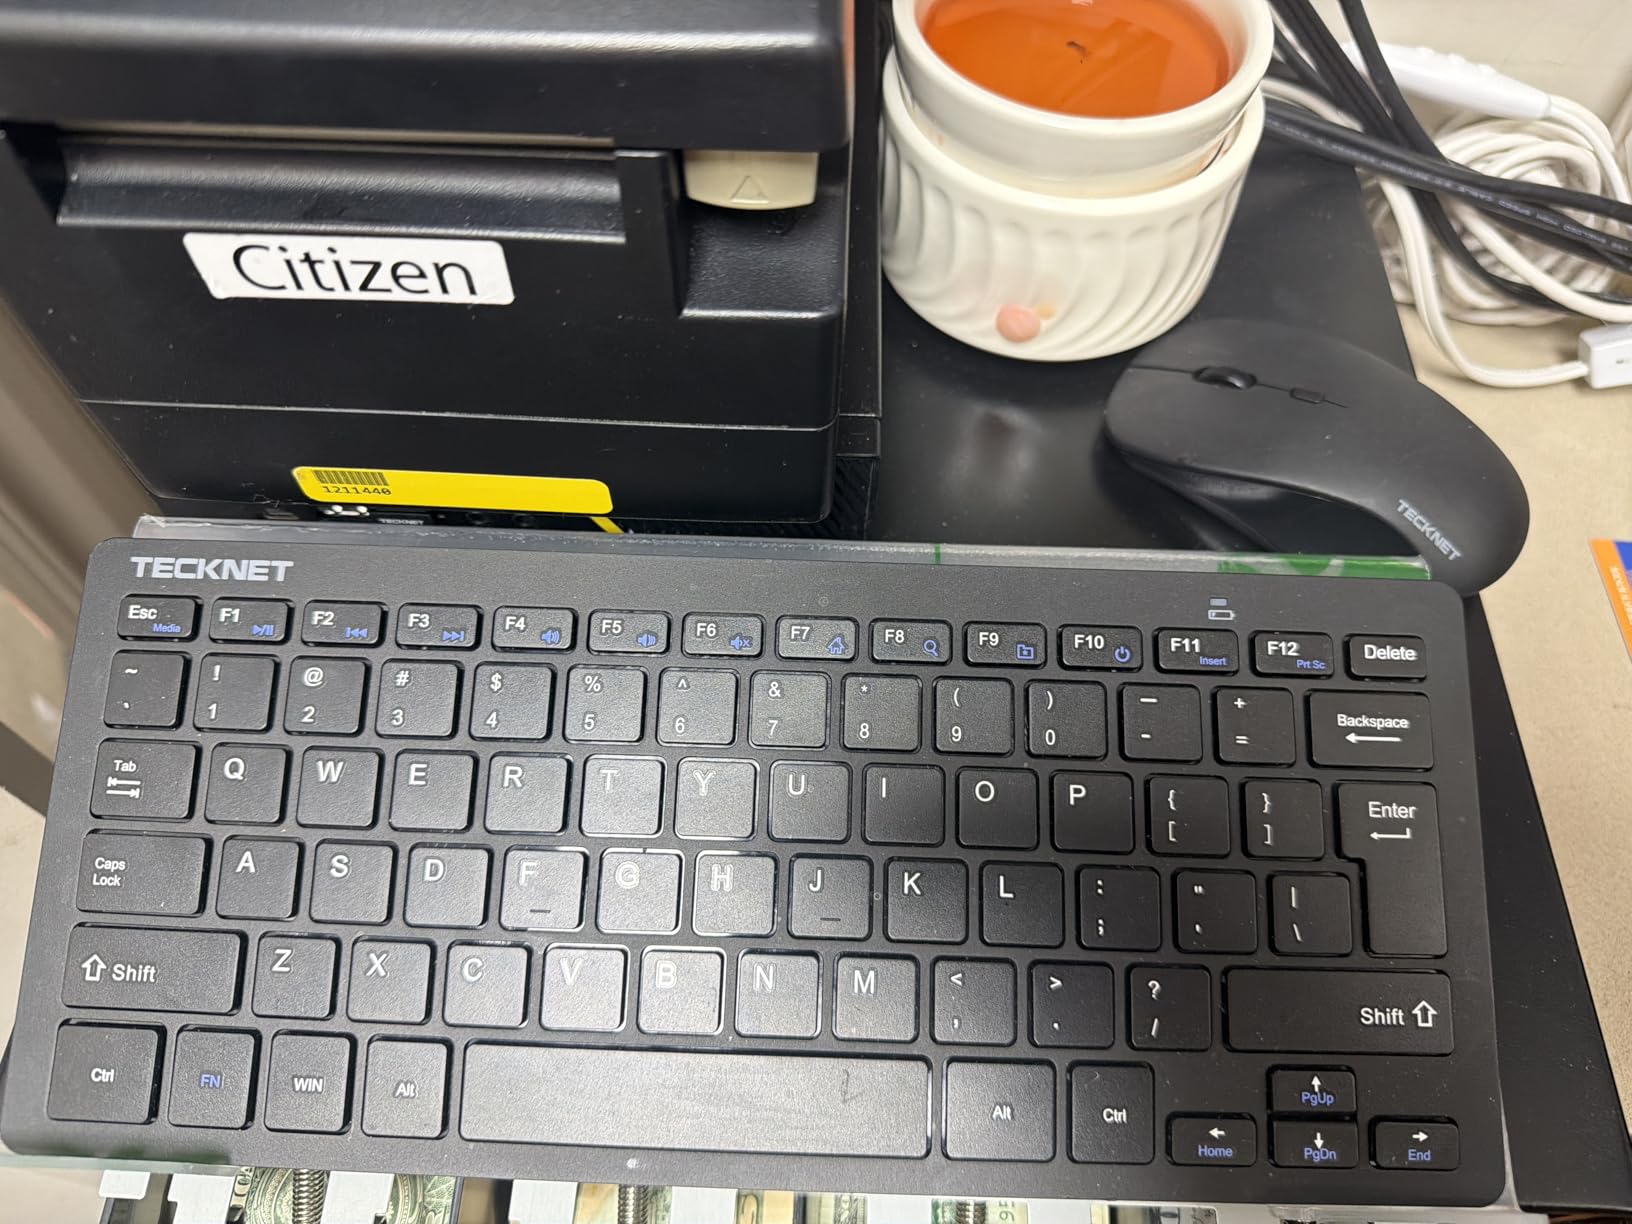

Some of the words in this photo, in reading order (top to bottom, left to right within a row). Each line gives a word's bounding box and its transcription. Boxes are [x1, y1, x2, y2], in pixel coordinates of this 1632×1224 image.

[232, 244, 476, 296] Citizen
[323, 484, 392, 496] 1211440
[1397, 499, 1462, 561] TECKNET
[131, 556, 294, 581] TECKNET
[128, 605, 157, 620] Esc
[219, 608, 240, 623] F1
[313, 611, 334, 627] F2
[152, 623, 181, 633] Media
[408, 613, 430, 629] F3
[505, 616, 526, 632] F4
[601, 620, 622, 634] F5
[696, 623, 717, 638] F6
[790, 626, 810, 640] F7
[885, 630, 905, 643] F8
[979, 632, 999, 647] F9
[1074, 635, 1105, 650] F10
[1170, 638, 1200, 653] F11
[1267, 641, 1300, 656] F12
[1364, 644, 1417, 661] Delete
[1199, 656, 1227, 666] Insert
[1296, 660, 1312, 669] Prt
[1313, 660, 1326, 670] Sc
[304, 668, 324, 687] @
[396, 670, 410, 687] #
[491, 672, 502, 691] $
[584, 676, 601, 692] %
[768, 682, 781, 697] &
[1234, 698, 1246, 709] +
[208, 704, 217, 720] 1
[303, 706, 315, 723] 2
[392, 709, 404, 726] 3
[486, 712, 498, 728] 4
[584, 715, 595, 730] 5
[675, 718, 685, 733] 6
[768, 721, 778, 736] 7
[1337, 714, 1409, 729] Backspace
[859, 724, 870, 739] 8
[951, 727, 962, 742] 9
[114, 760, 137, 772] Tab
[224, 757, 246, 781] Q
[316, 760, 344, 782] W
[409, 763, 427, 785] E
[504, 766, 523, 787] R
[600, 769, 619, 790] T
[694, 770, 715, 797] Y
[788, 775, 806, 795] U
[975, 781, 995, 802] O
[1069, 785, 1086, 805] P
[1262, 793, 1271, 813] }
[1369, 801, 1417, 819] Enter
[94, 858, 126, 872] Caps
[236, 851, 256, 873] A
[330, 855, 350, 877] S
[424, 859, 445, 881] D
[93, 873, 121, 887] Lock
[519, 862, 540, 885] F
[615, 861, 640, 888] G
[711, 863, 733, 892] H
[808, 869, 822, 892] J
[903, 872, 921, 895] K
[999, 875, 1014, 898] L
[1292, 923, 1302, 942] \
[272, 949, 292, 973] Z
[366, 953, 388, 977] X
[112, 964, 157, 982] Shift
[462, 958, 484, 982] C
[559, 958, 582, 987] V
[655, 960, 677, 989] B
[753, 963, 777, 992] N
[853, 970, 876, 995] M
[950, 972, 963, 985] <
[1049, 978, 1063, 989] >
[1148, 980, 1161, 1000] ?
[1360, 1007, 1405, 1026] Shift
[1151, 1018, 1160, 1037] /
[91, 1068, 114, 1083] Ctrl
[201, 1074, 222, 1089] FN
[293, 1077, 324, 1092] WIN
[396, 1083, 418, 1097] Alt
[1301, 1090, 1335, 1106] PgUp
[992, 1105, 1011, 1121] Alt
[1103, 1108, 1127, 1124] Ctrl
[1198, 1145, 1233, 1157] Home
[1304, 1147, 1336, 1162] PgDn
[1408, 1149, 1431, 1161] End
